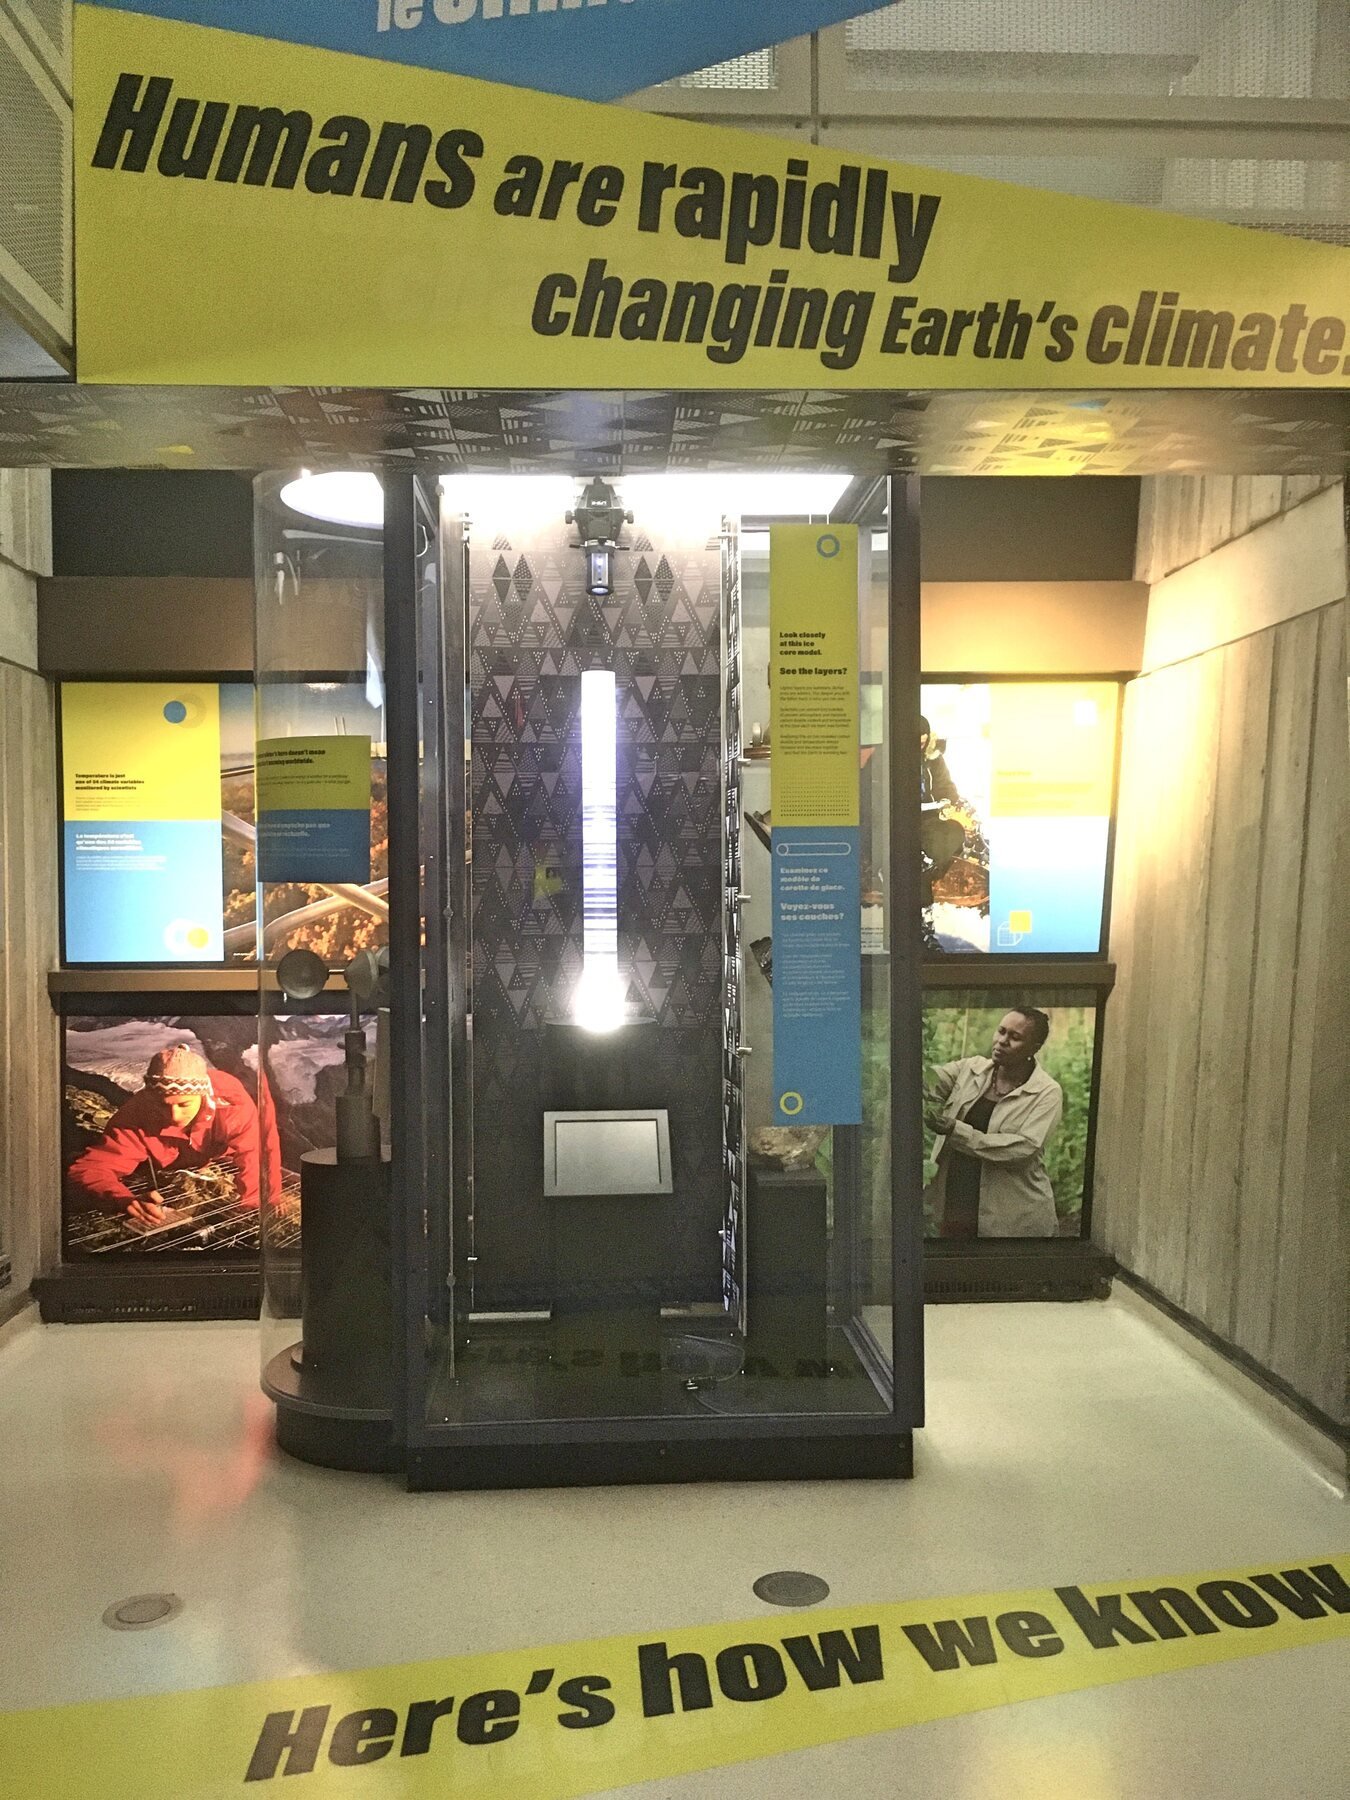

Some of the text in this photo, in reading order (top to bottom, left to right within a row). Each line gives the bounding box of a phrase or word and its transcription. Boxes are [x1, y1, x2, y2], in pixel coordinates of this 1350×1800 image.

[91, 73, 942, 284] Humans are rapidly
[531, 259, 875, 370] changing
[880, 296, 1079, 363] Earth's
[799, 632, 826, 640] closely
[780, 667, 848, 677] See the layers?
[800, 913, 845, 921] couches?
[244, 1563, 1350, 1783] Here's how we know
